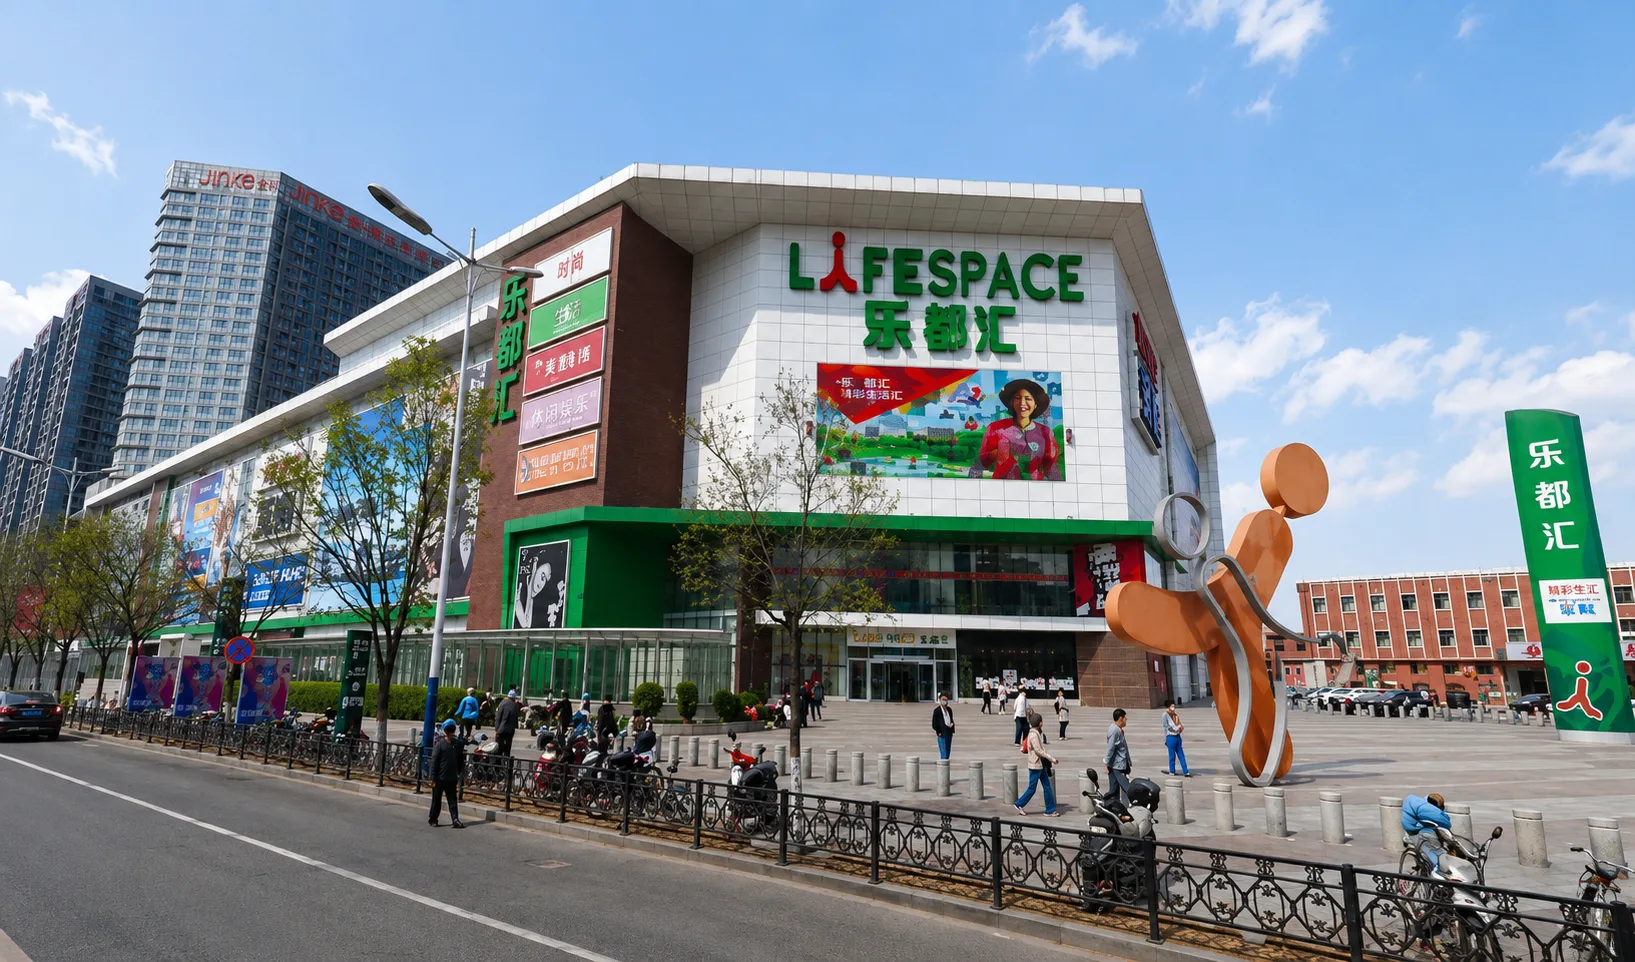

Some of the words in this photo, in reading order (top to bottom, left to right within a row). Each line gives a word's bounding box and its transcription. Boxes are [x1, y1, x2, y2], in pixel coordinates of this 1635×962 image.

[557, 249, 584, 279] 时尚
[490, 273, 528, 425] 乐都汇
[863, 300, 1017, 354] 乐都汇
[1528, 438, 1580, 551] 乐都汇
